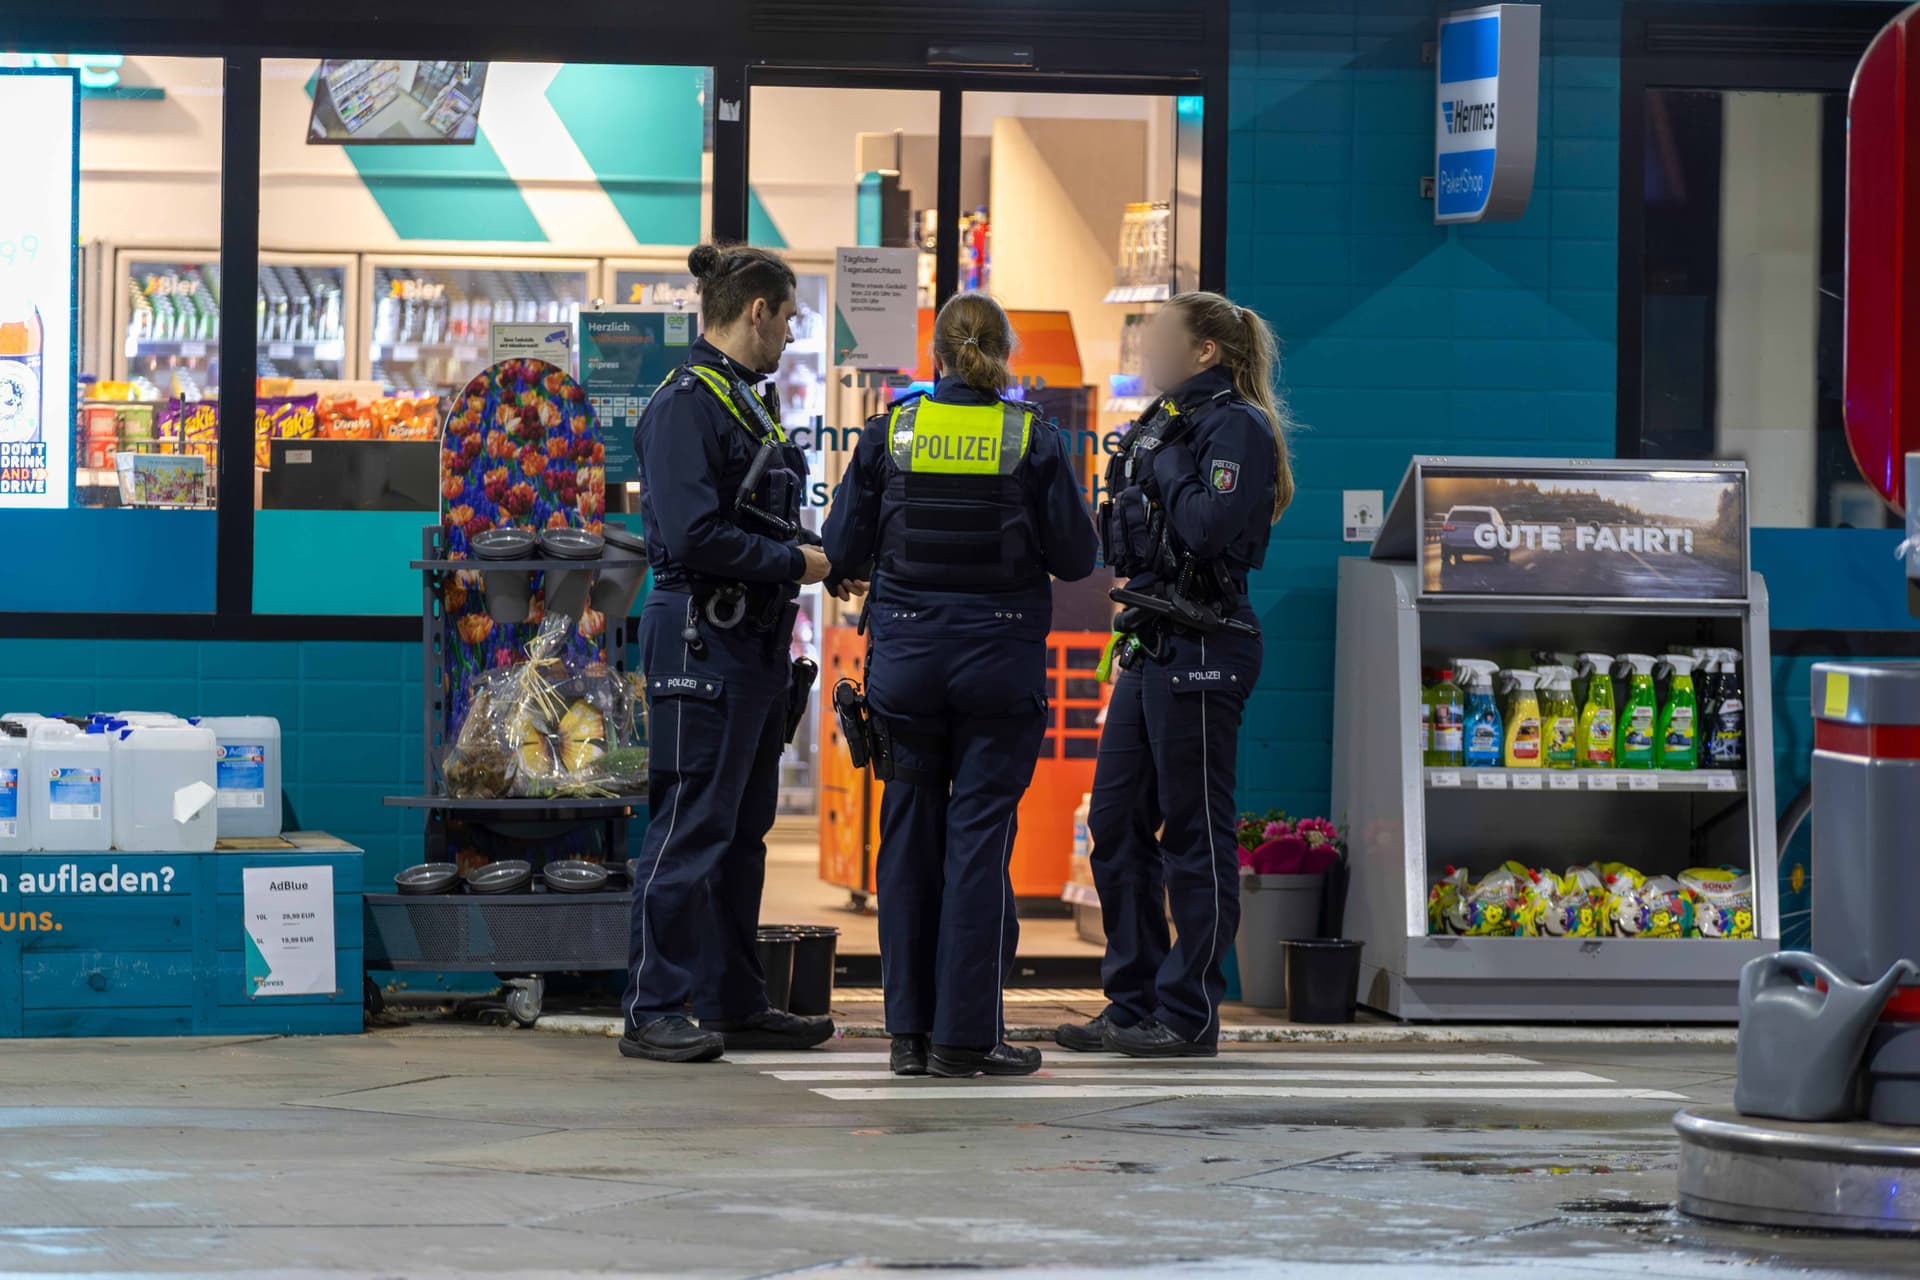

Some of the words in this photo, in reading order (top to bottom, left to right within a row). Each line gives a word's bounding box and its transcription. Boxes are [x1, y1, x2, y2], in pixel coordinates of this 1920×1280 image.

[1454, 100, 1496, 134] Hermes
[1440, 167, 1484, 199] PaketShop
[160, 275, 201, 296] Bier
[403, 278, 444, 299] Bier
[588, 322, 630, 332] Herzlich
[279, 406, 316, 438] Takis
[1, 443, 45, 456] DON'T
[914, 434, 997, 462] POLIZEI
[1, 455, 45, 468] DRINK
[2, 469, 30, 480] AND
[1, 481, 45, 493] DRIVE
[1473, 523, 1562, 551] GUTE
[1576, 526, 1694, 554] FAHRT!
[667, 678, 697, 689] POLIZEI
[1189, 670, 1221, 681] POLIZEI
[18, 863, 175, 893] aufladen?
[269, 880, 309, 892] AdBlue
[0, 911, 63, 932] uns.
